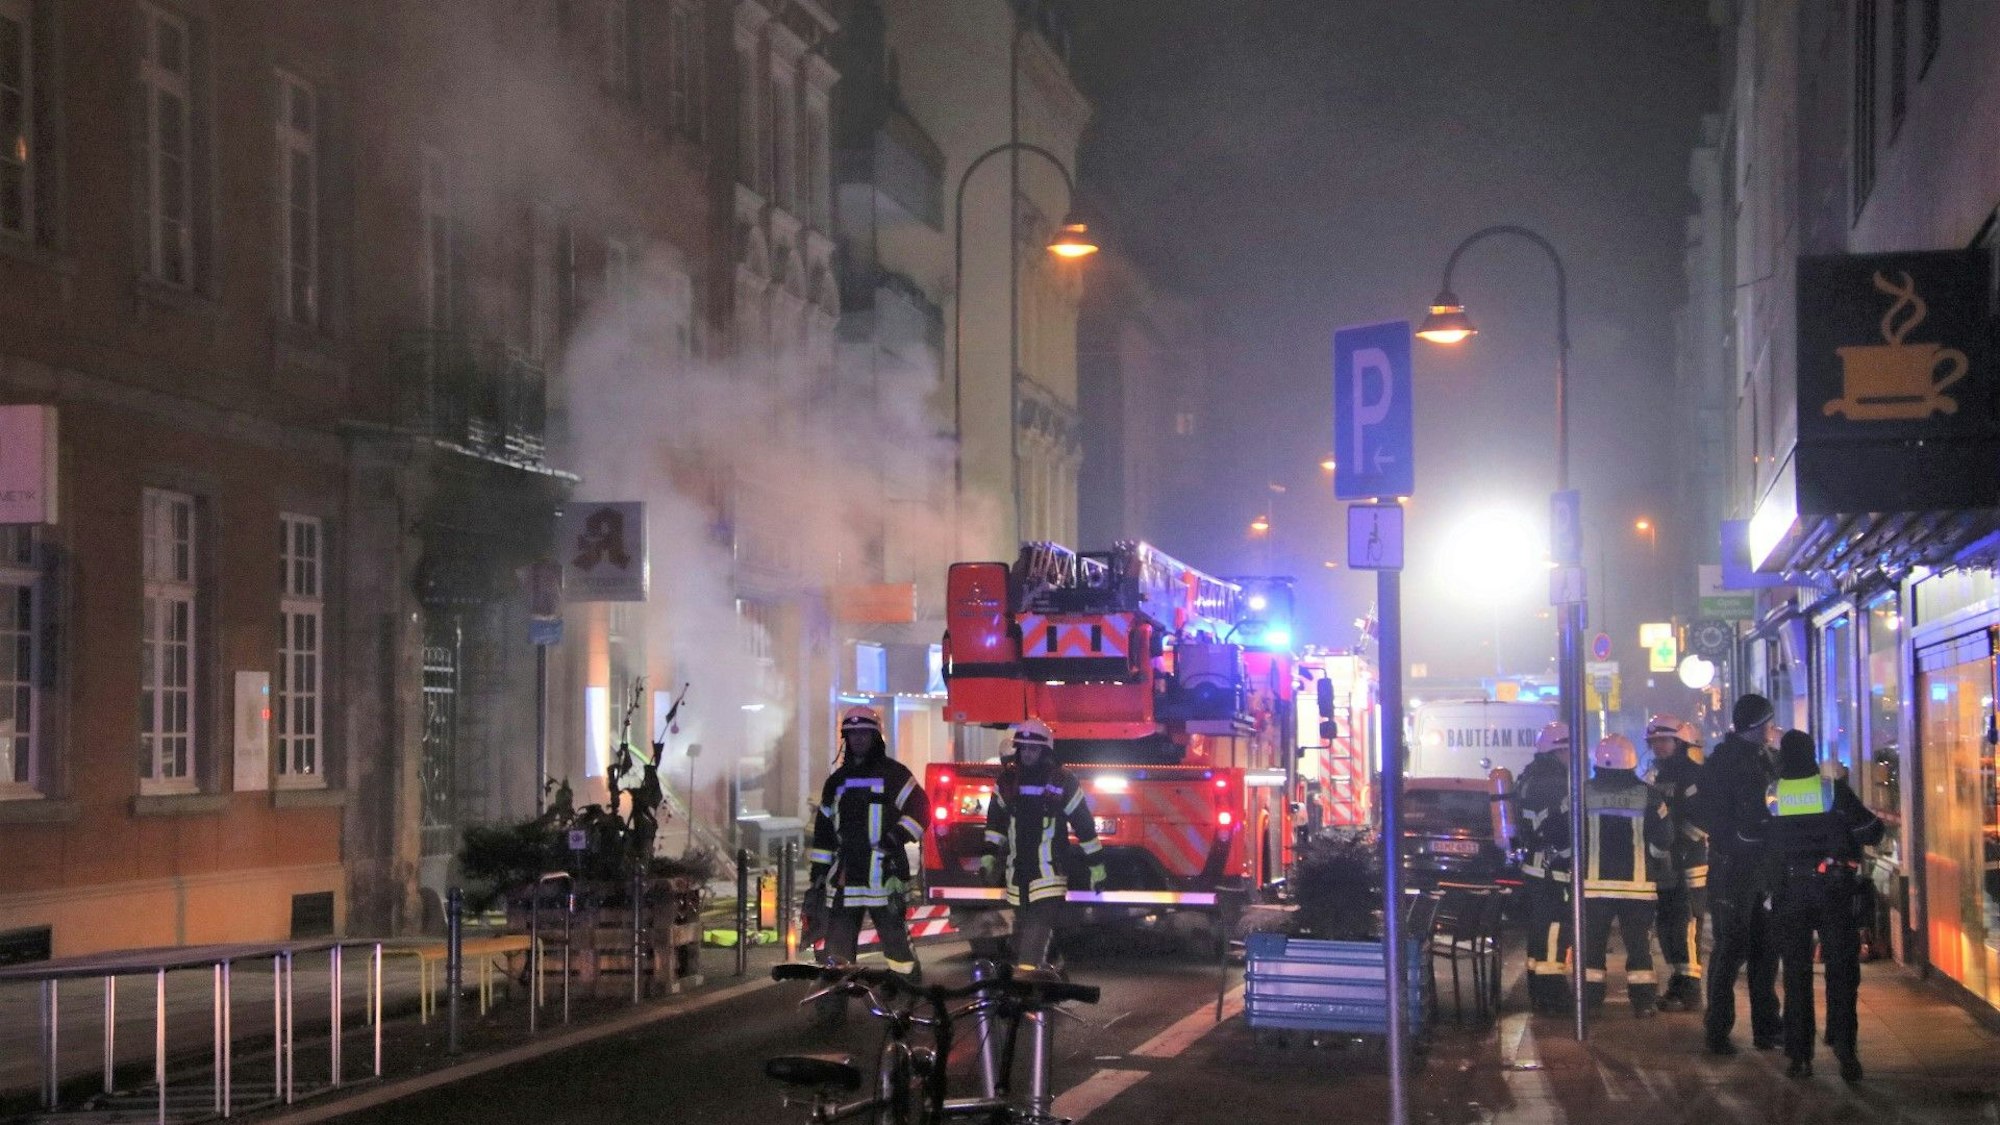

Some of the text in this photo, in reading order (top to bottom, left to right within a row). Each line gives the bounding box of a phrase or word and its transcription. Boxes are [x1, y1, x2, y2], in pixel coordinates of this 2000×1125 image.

[1353, 347, 1394, 475] P
[1447, 728, 1512, 748] BAUTEAM
[1779, 792, 1820, 806] POLIZEI
